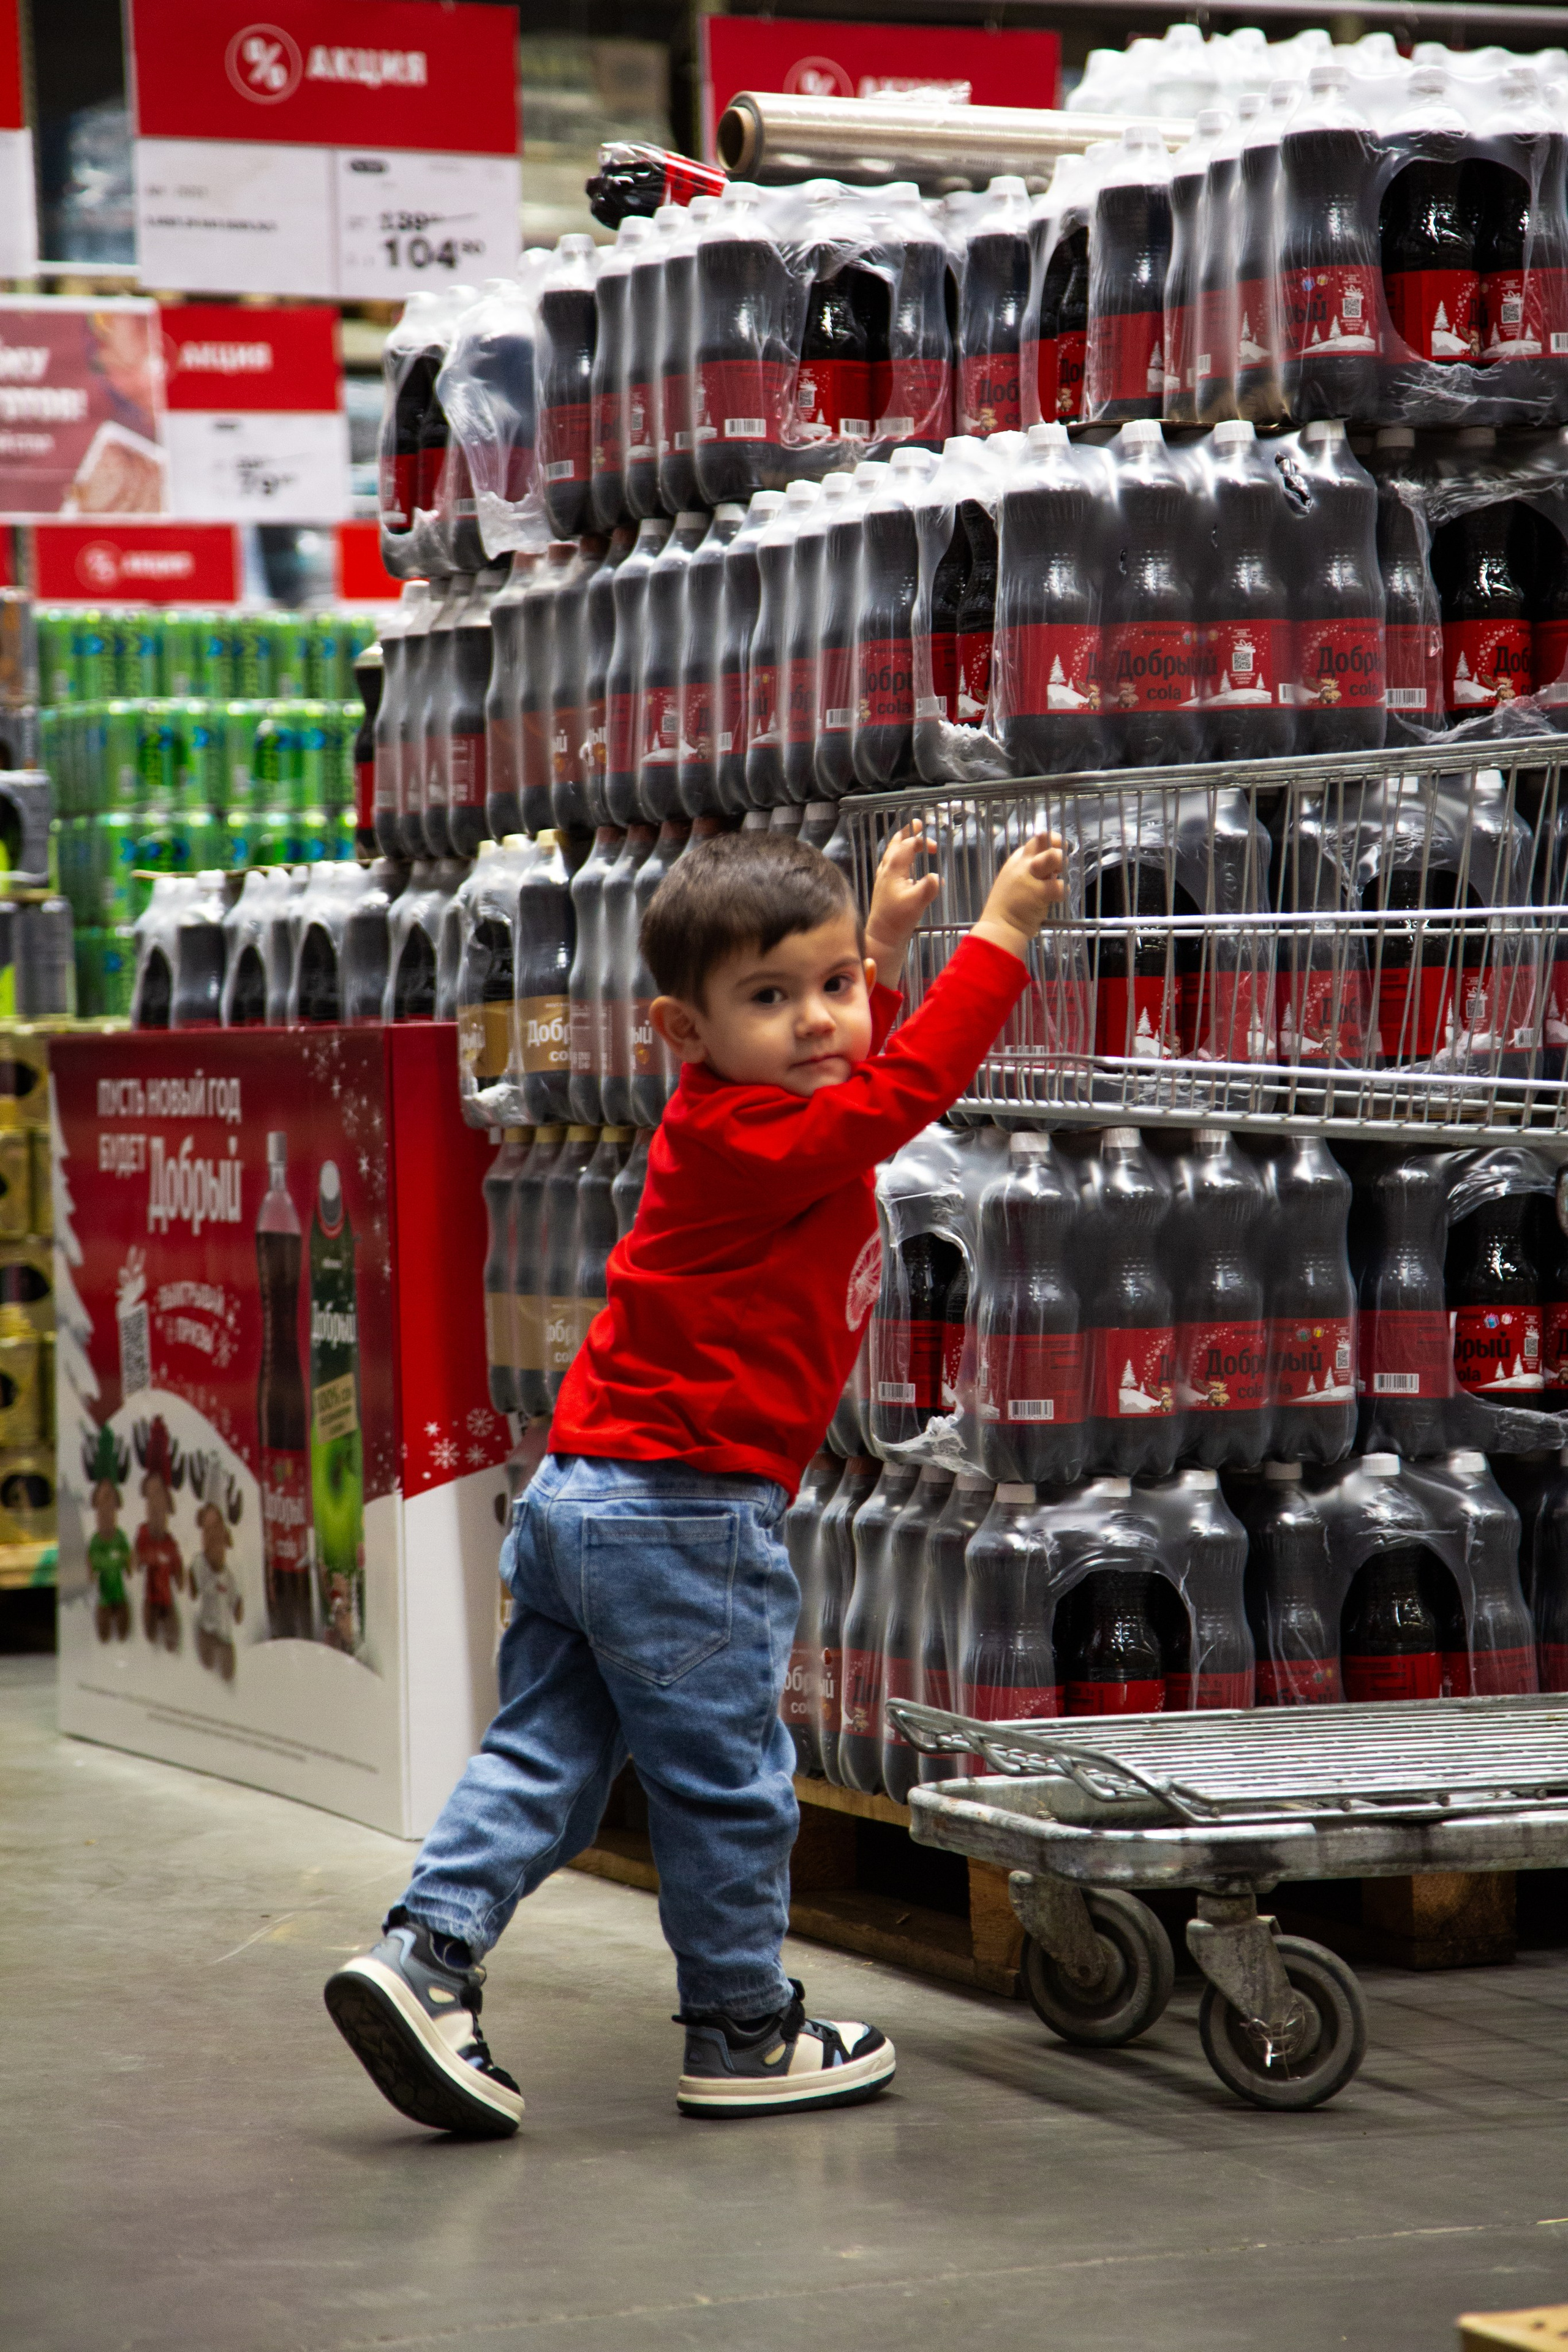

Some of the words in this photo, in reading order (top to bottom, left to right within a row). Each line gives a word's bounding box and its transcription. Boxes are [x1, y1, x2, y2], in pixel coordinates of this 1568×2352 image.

[307, 45, 428, 89] АКЦИЯ
[383, 236, 457, 269] 104
[1147, 684, 1182, 700] cola
[97, 1077, 145, 1117] ПУСТЬ
[146, 1068, 206, 1117] НОВЫЙ
[208, 1077, 242, 1125] ГОД
[98, 1134, 146, 1179] БУДЕТ
[147, 1135, 242, 1237] Добрый
[310, 1300, 358, 1350] Добрый
[1457, 1366, 1481, 1382] ola
